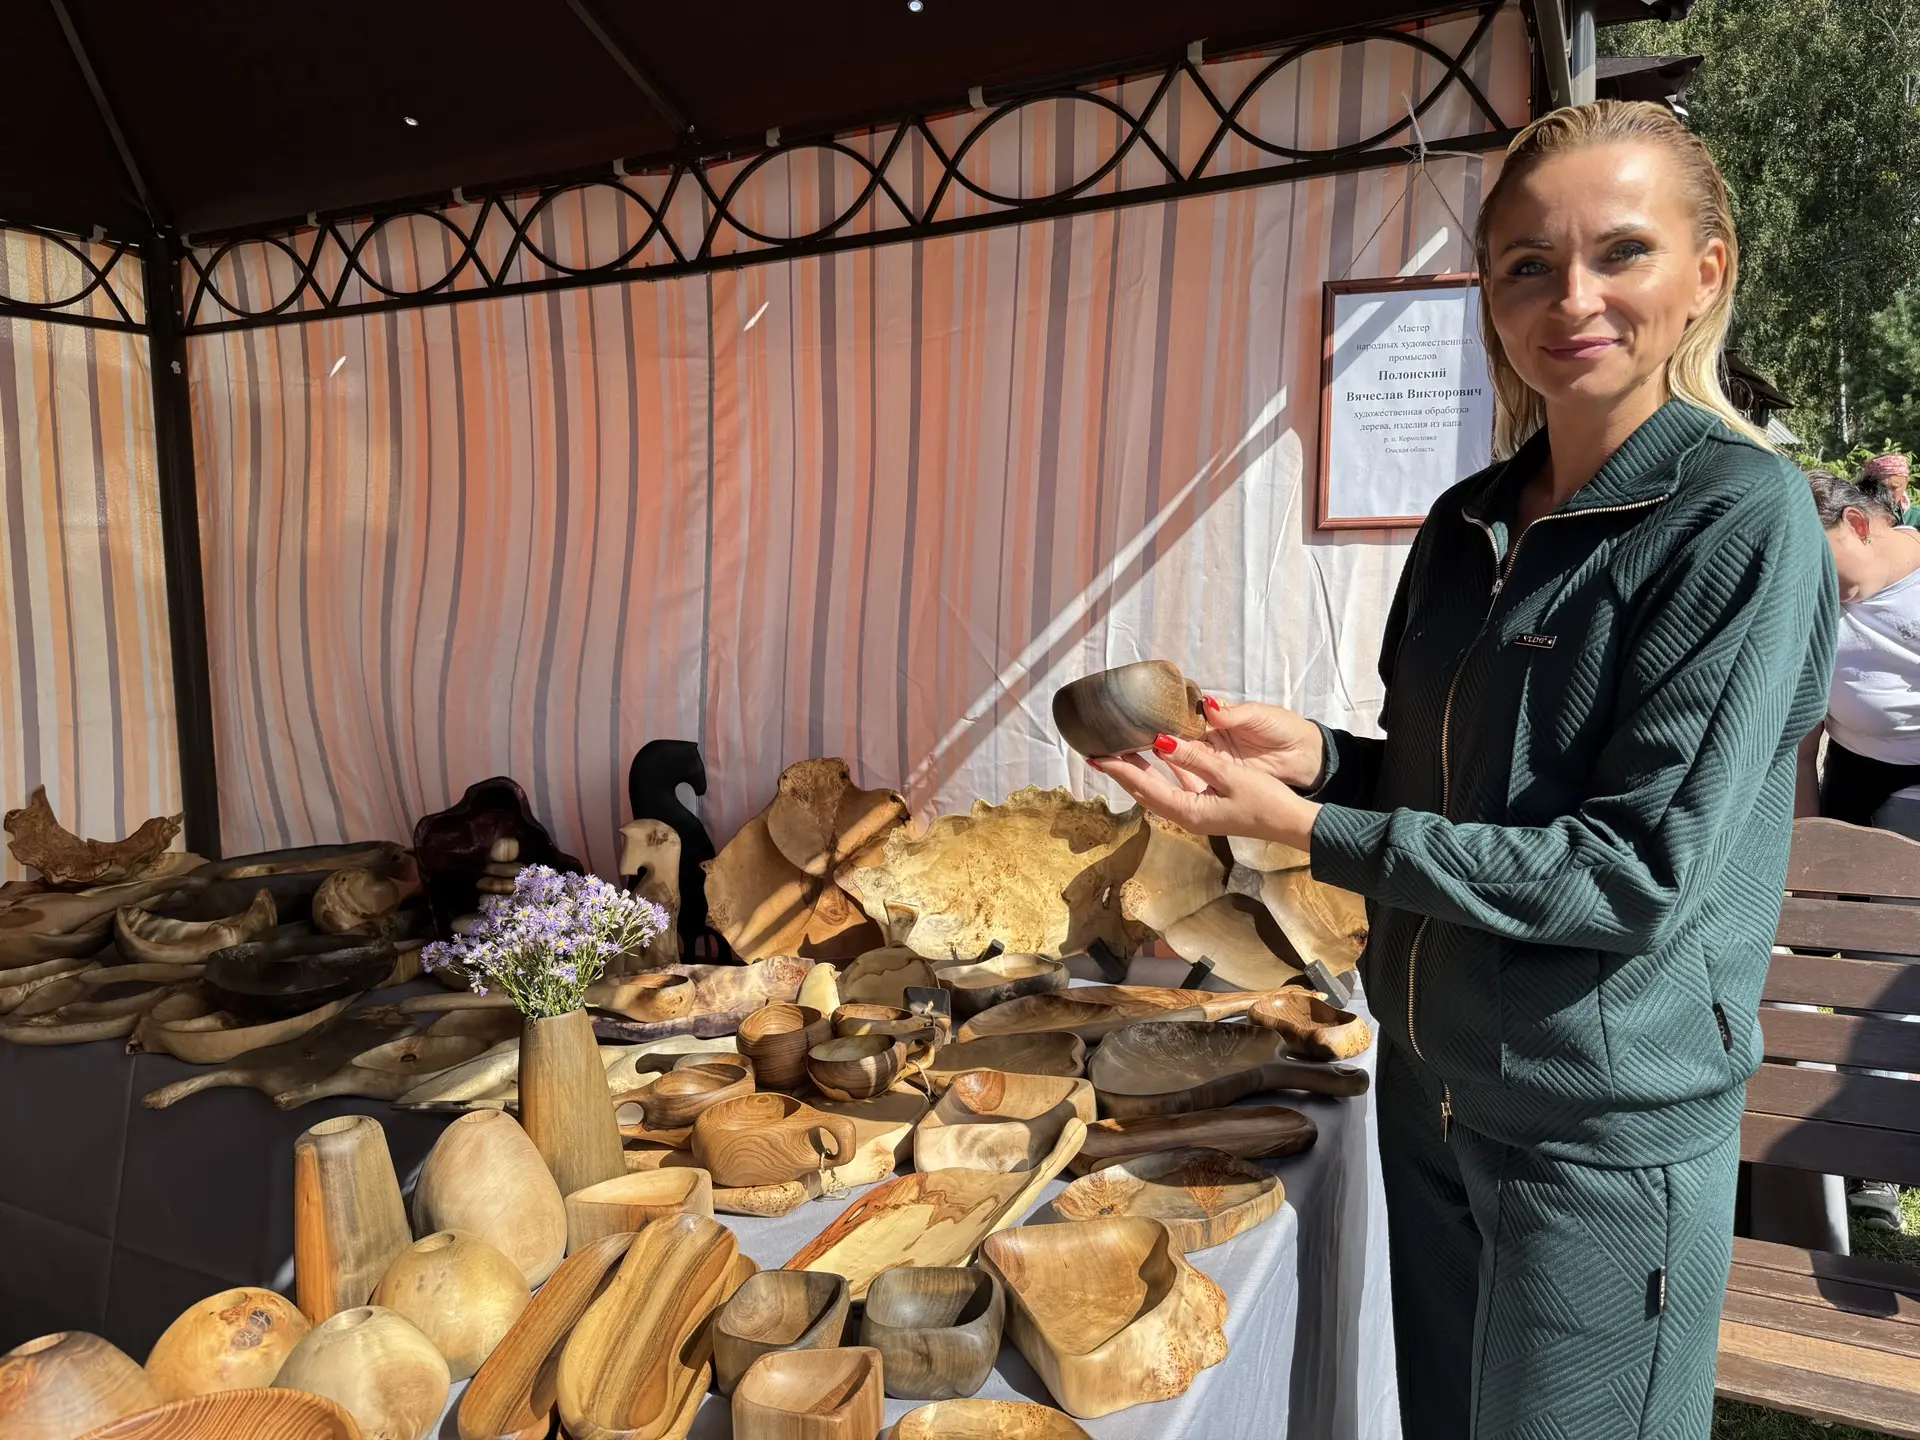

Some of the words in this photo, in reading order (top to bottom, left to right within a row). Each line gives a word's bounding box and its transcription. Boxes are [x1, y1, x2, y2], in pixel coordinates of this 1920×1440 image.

[1397, 324, 1430, 334] Мастер
[1356, 341, 1399, 353] народных
[1400, 337, 1474, 350] художественных
[1388, 353, 1437, 363] промыслов
[1378, 368, 1447, 381] Полонский
[1346, 391, 1404, 401] Вячеслав
[1407, 388, 1482, 400] Викторович
[1353, 408, 1422, 420] художественная
[1424, 406, 1470, 417] обработка
[1359, 423, 1391, 433] дерева,
[1393, 420, 1428, 430] изделия
[1442, 420, 1462, 428] капа
